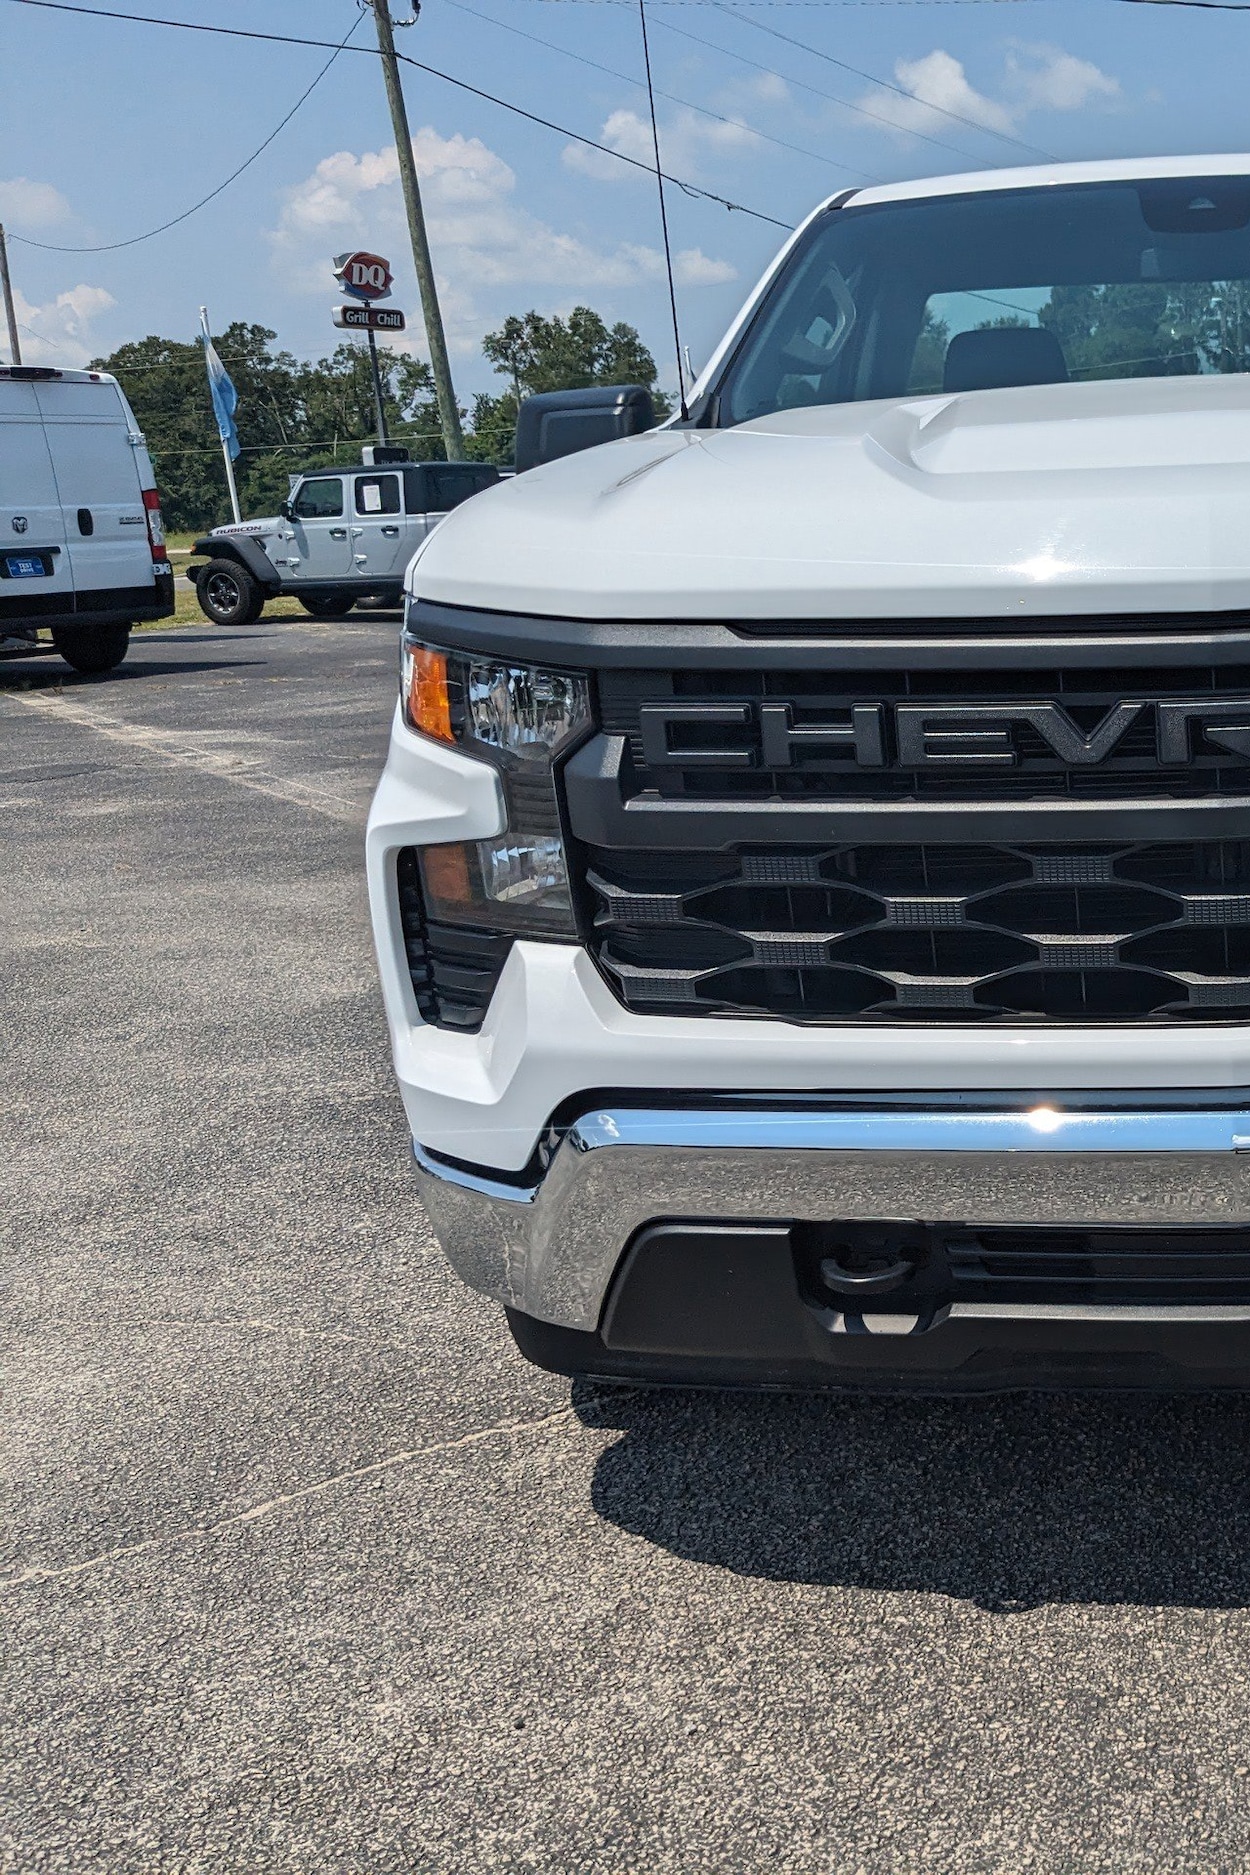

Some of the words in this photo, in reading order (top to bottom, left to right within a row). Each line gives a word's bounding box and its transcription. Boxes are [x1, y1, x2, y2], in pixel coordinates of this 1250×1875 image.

[352, 262, 386, 290] DQ
[346, 311, 369, 324] Grill
[377, 313, 401, 327] Chill
[216, 525, 262, 535] RUBICON
